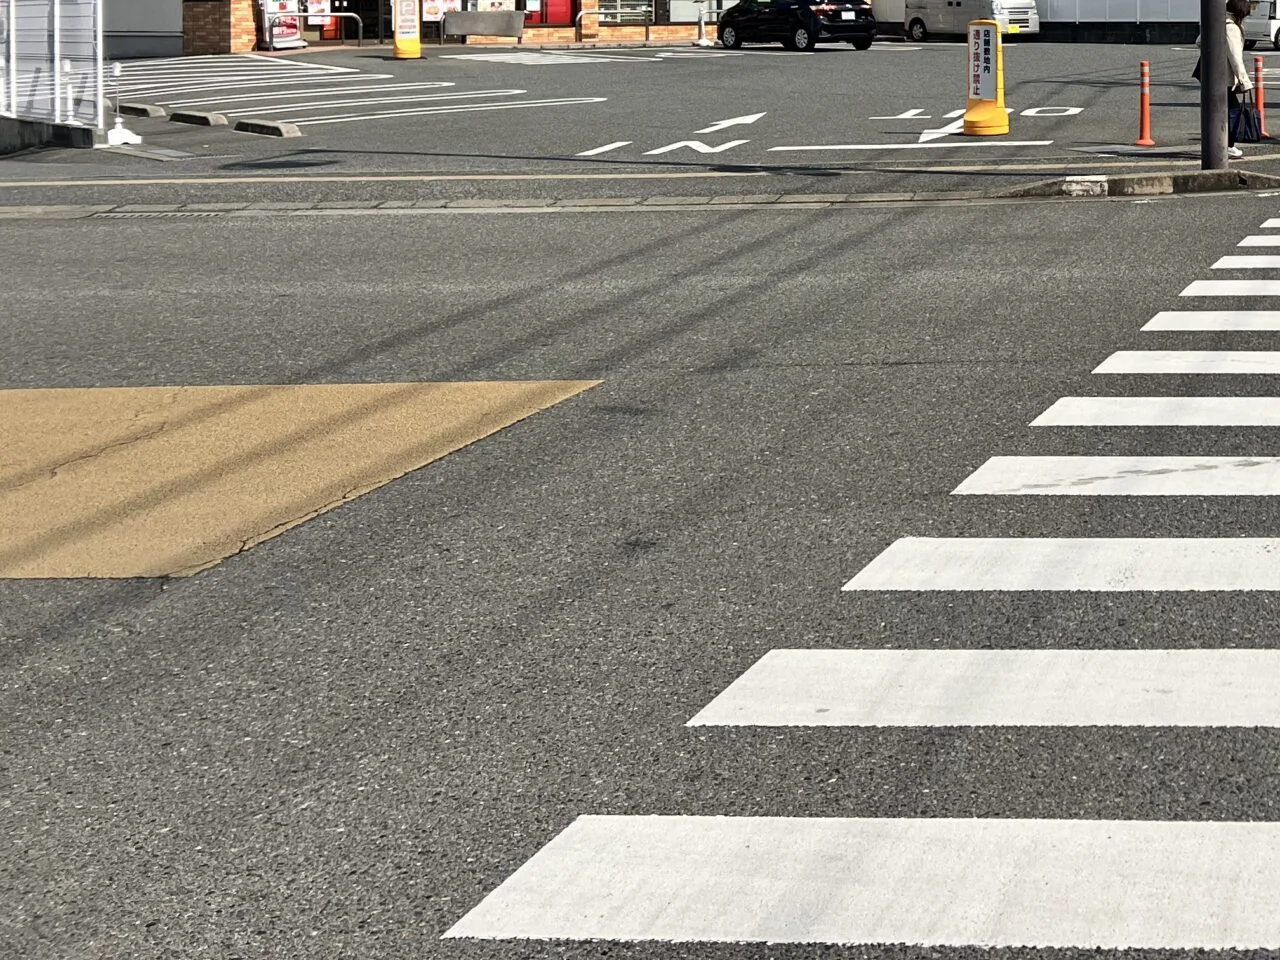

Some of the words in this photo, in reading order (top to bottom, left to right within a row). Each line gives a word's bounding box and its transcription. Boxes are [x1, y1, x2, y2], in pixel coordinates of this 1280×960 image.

[972, 29, 980, 97] 通り抜け禁止
[983, 29, 991, 75] 店舗敷地内
